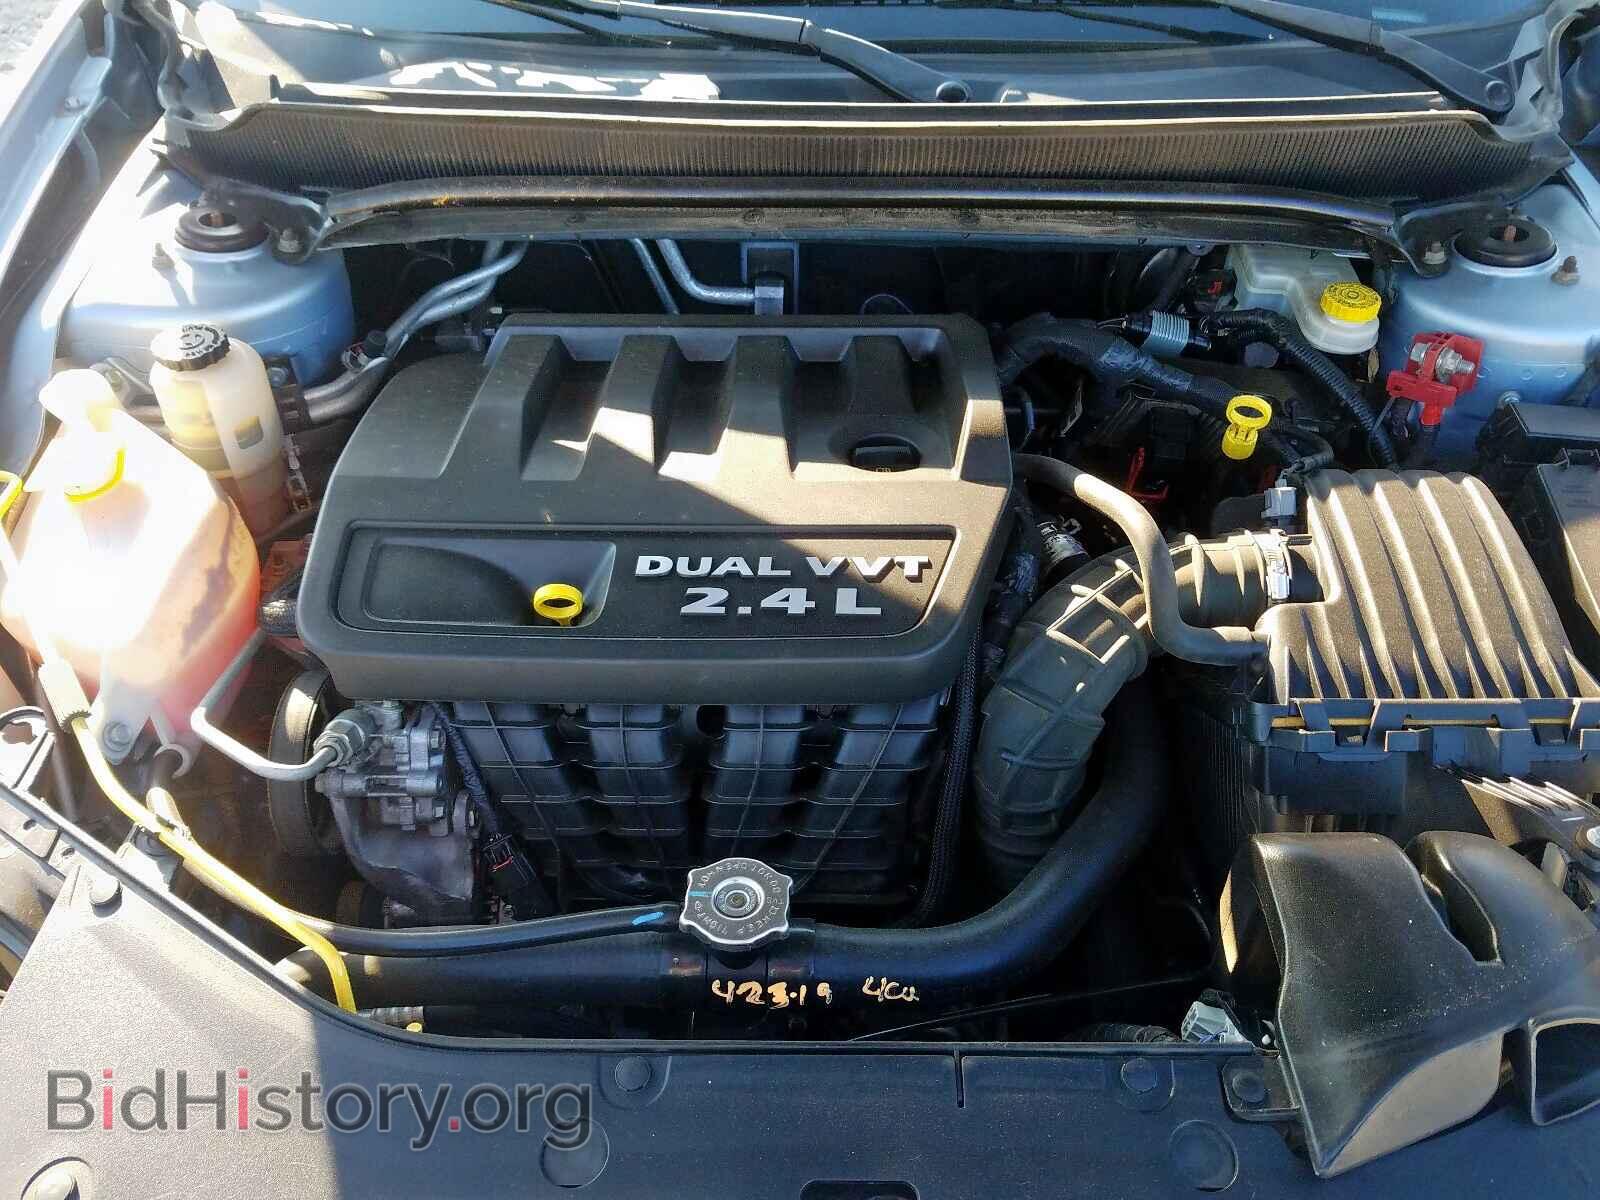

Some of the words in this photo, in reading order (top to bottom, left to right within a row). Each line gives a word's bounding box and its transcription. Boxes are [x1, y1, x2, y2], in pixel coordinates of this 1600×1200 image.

[635, 555, 792, 577] DUAL
[806, 556, 930, 582] VVT
[680, 587, 816, 616] 2.4
[835, 588, 882, 615] L
